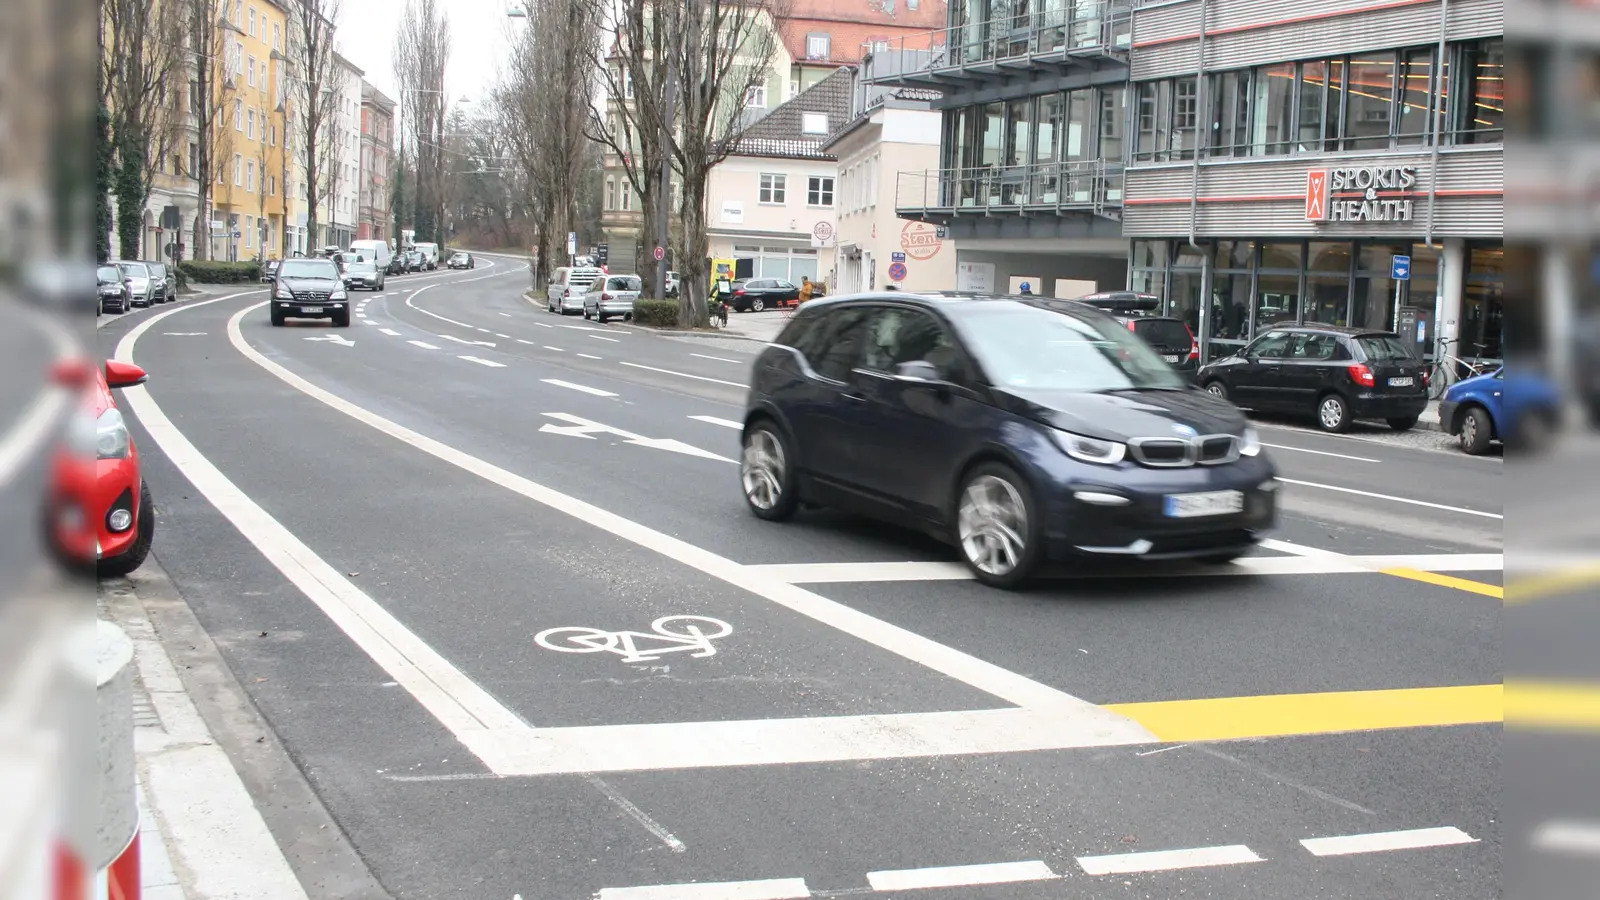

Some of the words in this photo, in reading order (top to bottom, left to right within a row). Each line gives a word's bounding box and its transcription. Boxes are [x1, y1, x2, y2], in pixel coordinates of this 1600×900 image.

[1331, 165, 1415, 190] SPORTS
[1365, 187, 1378, 200] &
[1330, 200, 1412, 221] HEALTH
